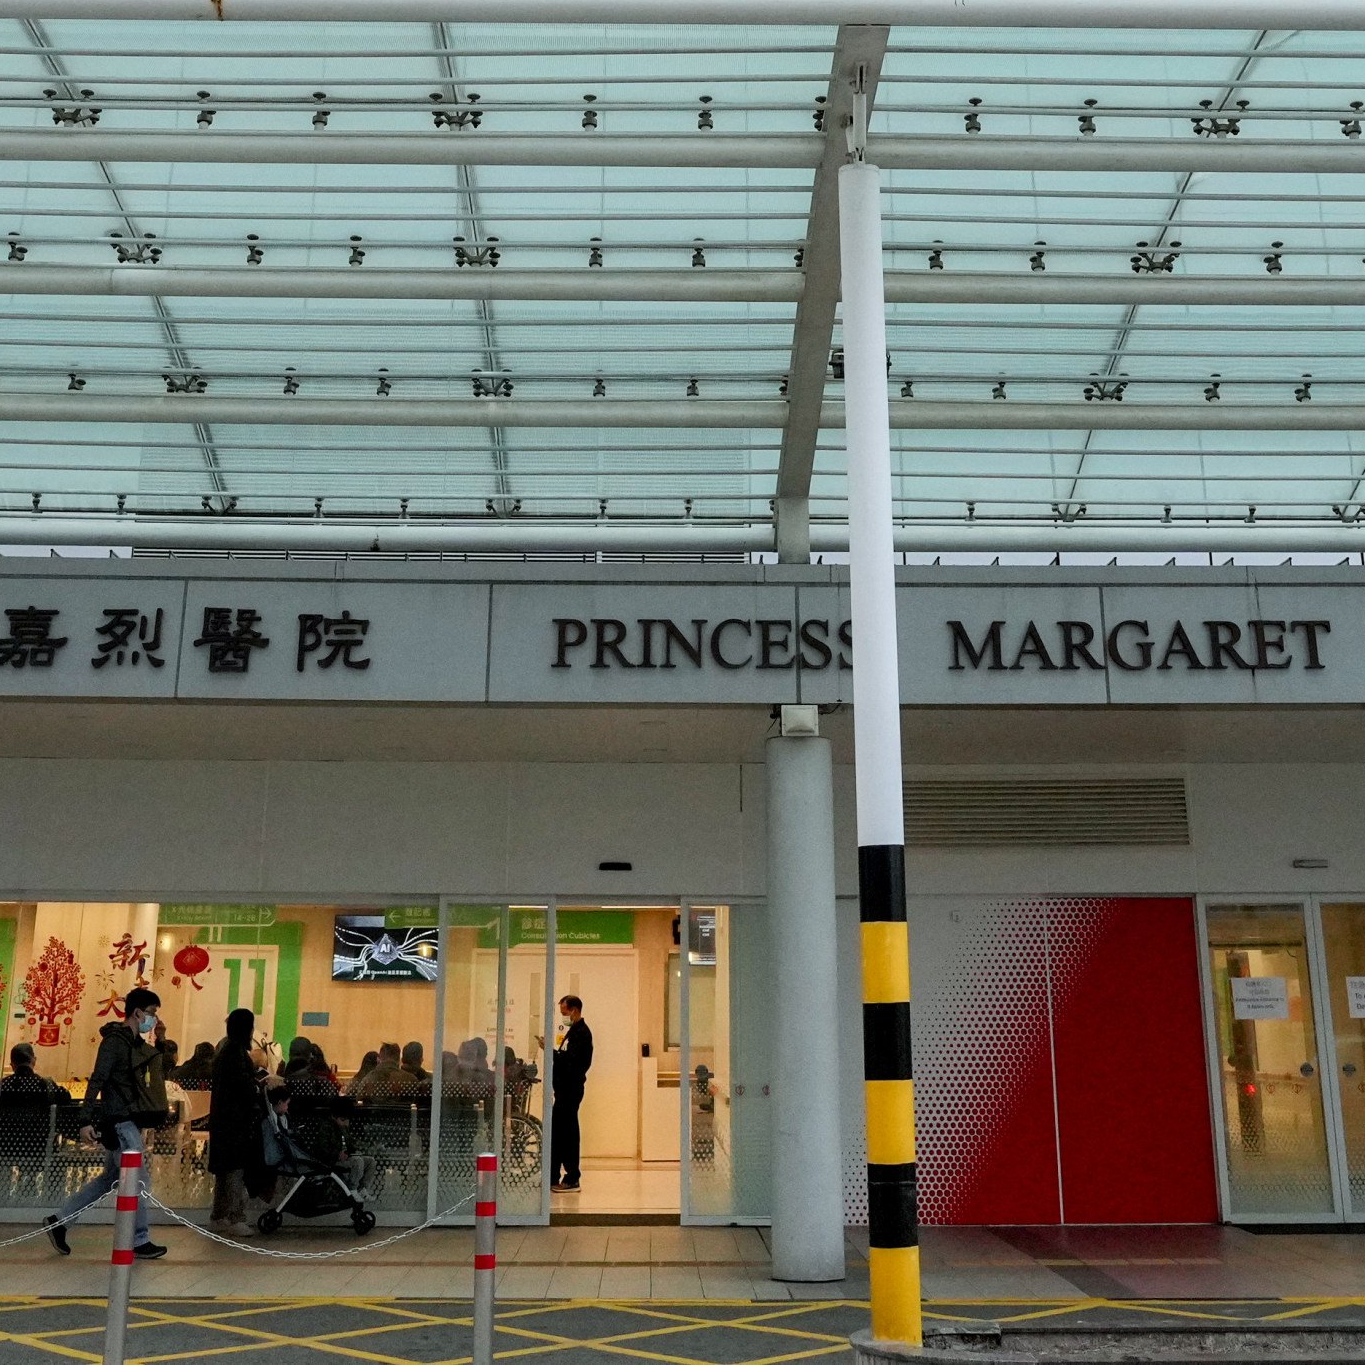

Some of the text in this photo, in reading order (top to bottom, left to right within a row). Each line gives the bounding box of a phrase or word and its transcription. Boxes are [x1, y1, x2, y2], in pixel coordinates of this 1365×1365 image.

[947, 618, 1332, 672] MARGARET
[380, 943, 391, 953] AI
[223, 958, 267, 1016] 11
